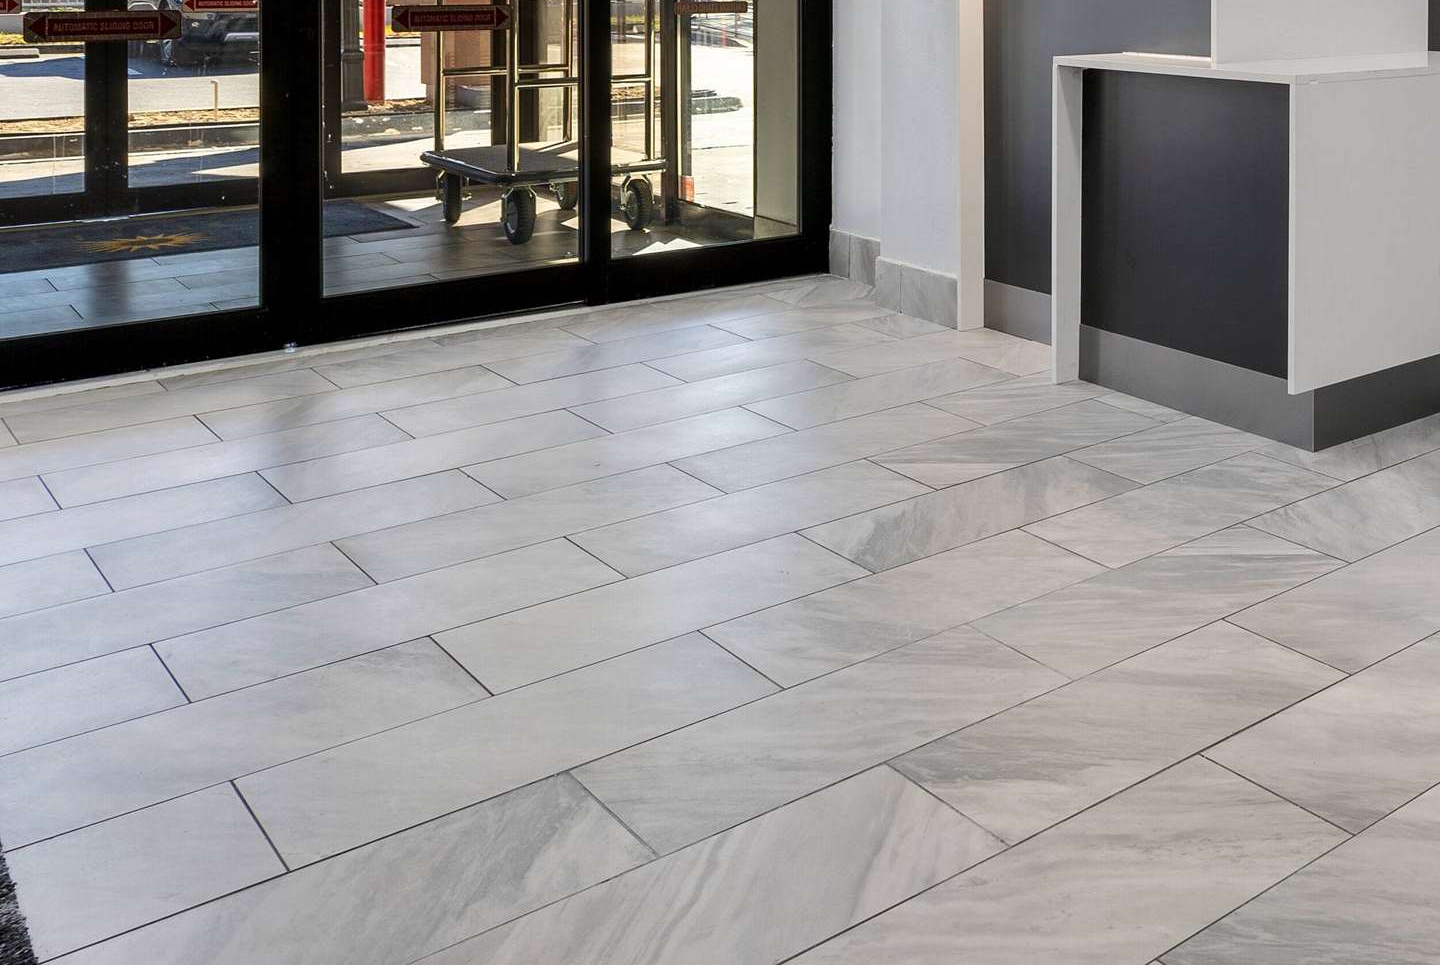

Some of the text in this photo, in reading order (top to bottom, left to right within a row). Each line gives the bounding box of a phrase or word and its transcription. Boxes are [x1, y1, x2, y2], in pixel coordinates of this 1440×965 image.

[53, 20, 155, 32] AUTOMATIC SLIDING DOOR
